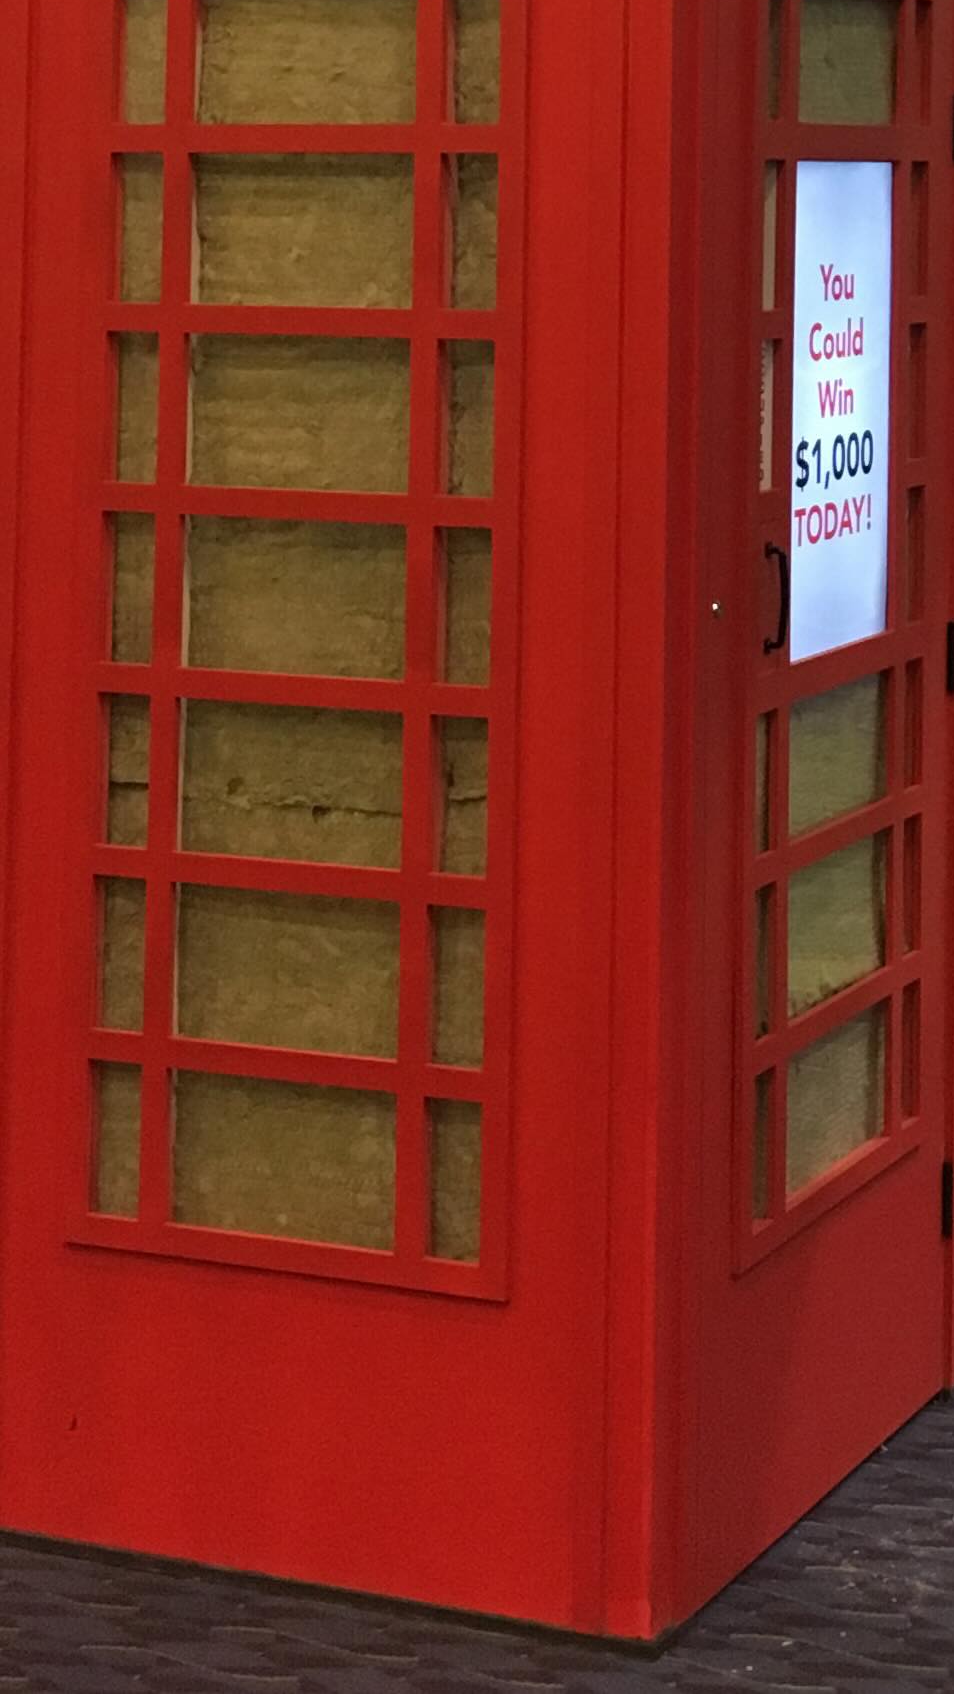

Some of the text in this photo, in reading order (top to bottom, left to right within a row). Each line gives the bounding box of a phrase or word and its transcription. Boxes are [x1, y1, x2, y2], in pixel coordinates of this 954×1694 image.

[820, 264, 854, 301] You
[809, 318, 864, 361] Could
[818, 379, 854, 418] Win
[795, 429, 874, 492] $1,000
[794, 494, 872, 547] TODAY!
